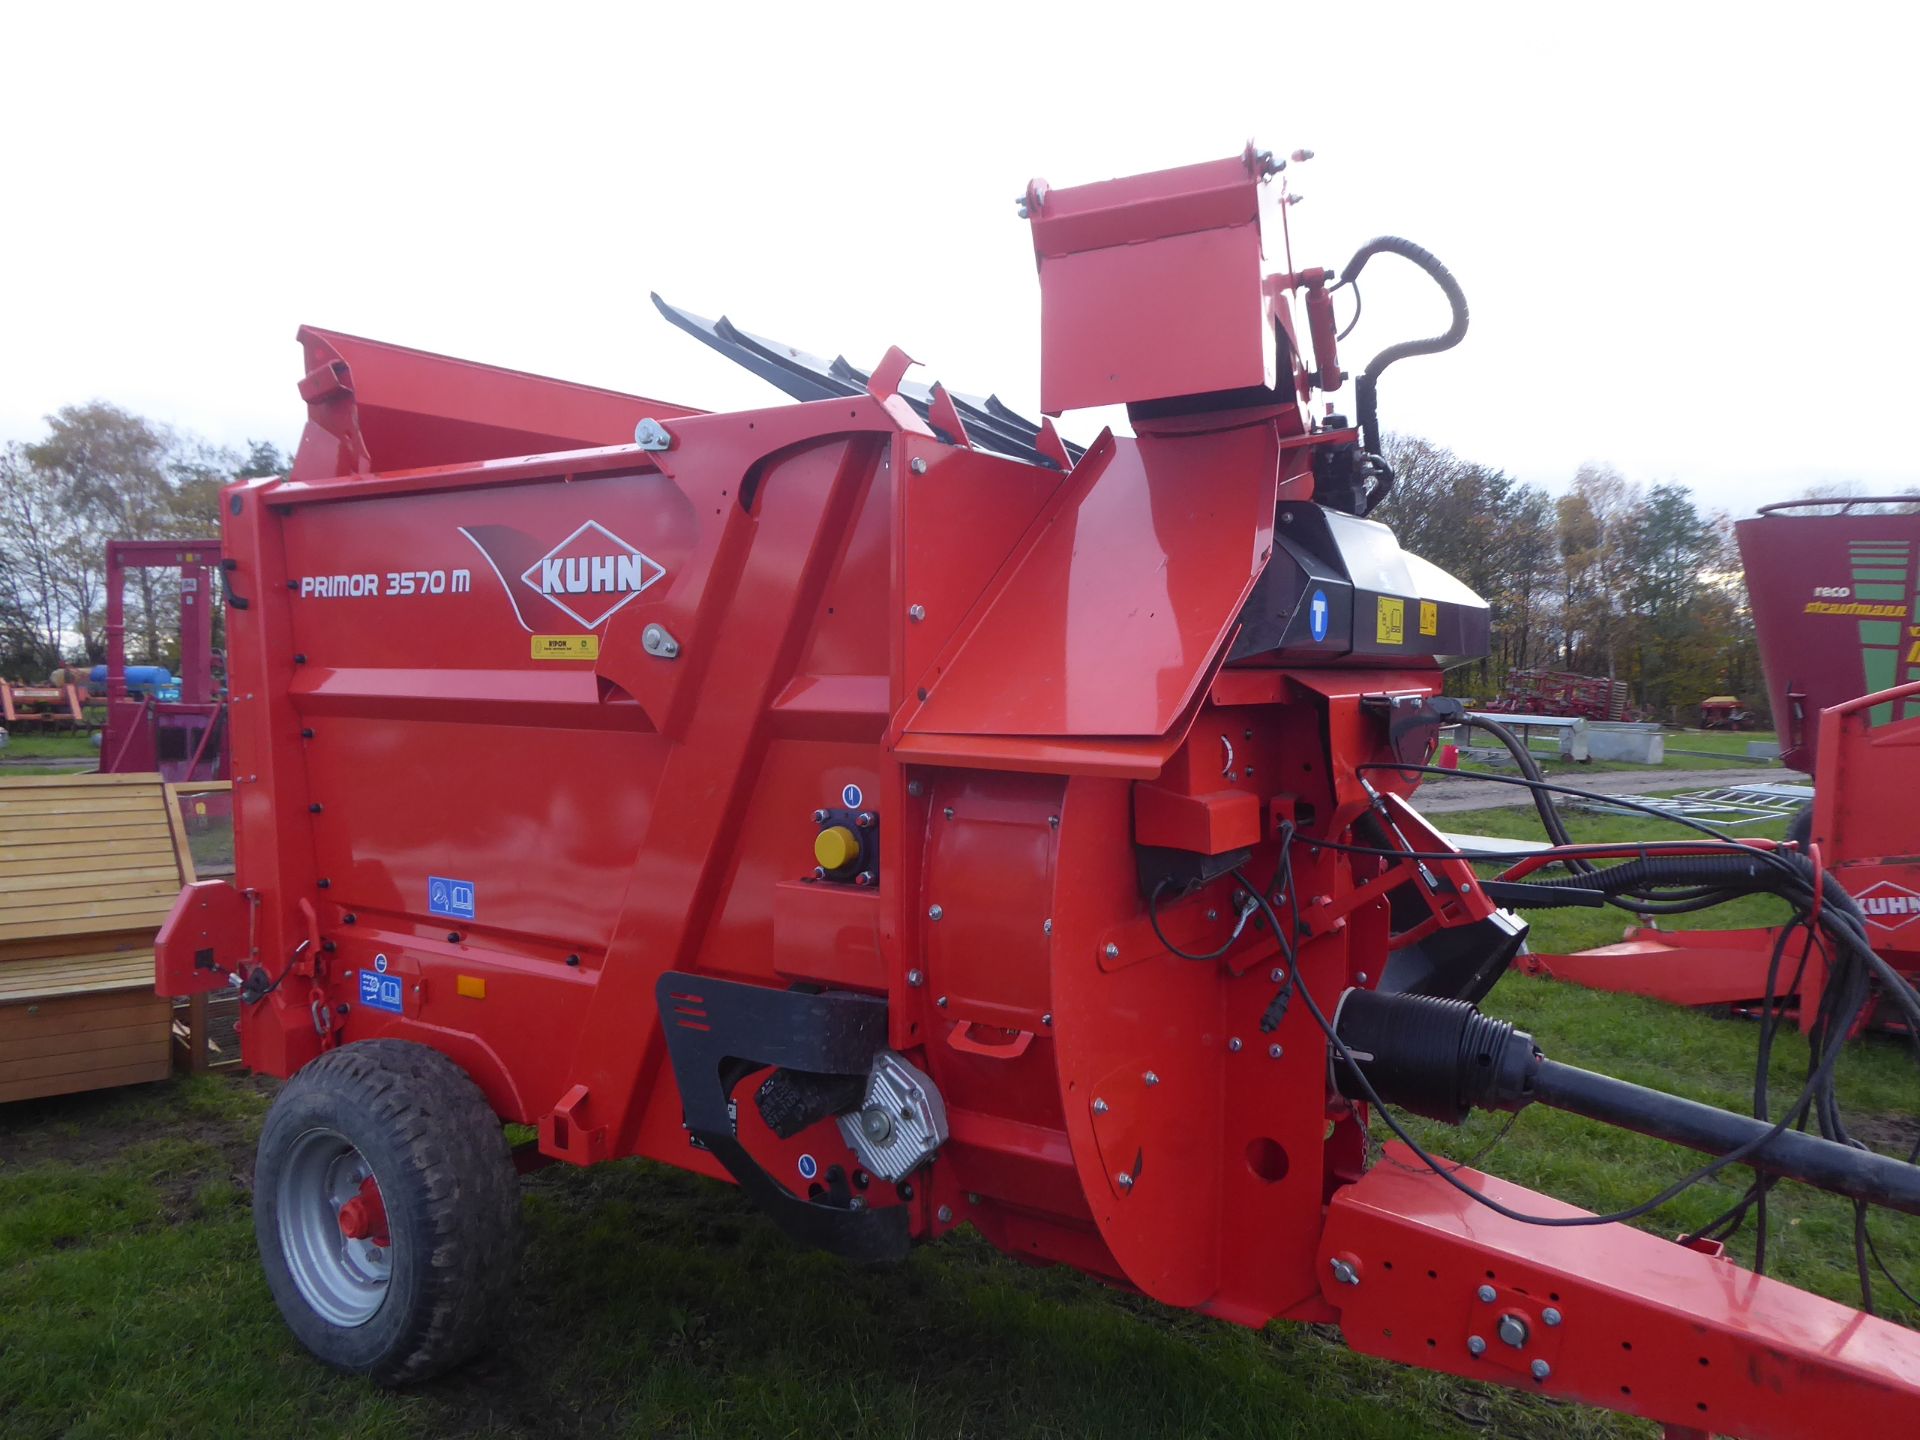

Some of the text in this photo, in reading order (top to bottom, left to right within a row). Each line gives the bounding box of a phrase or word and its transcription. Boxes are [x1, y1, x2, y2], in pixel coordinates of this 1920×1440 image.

[301, 574, 378, 598] PRIMOR
[386, 570, 445, 595] 3570
[542, 554, 642, 594] KUHN
[1814, 587, 1850, 598] reco
